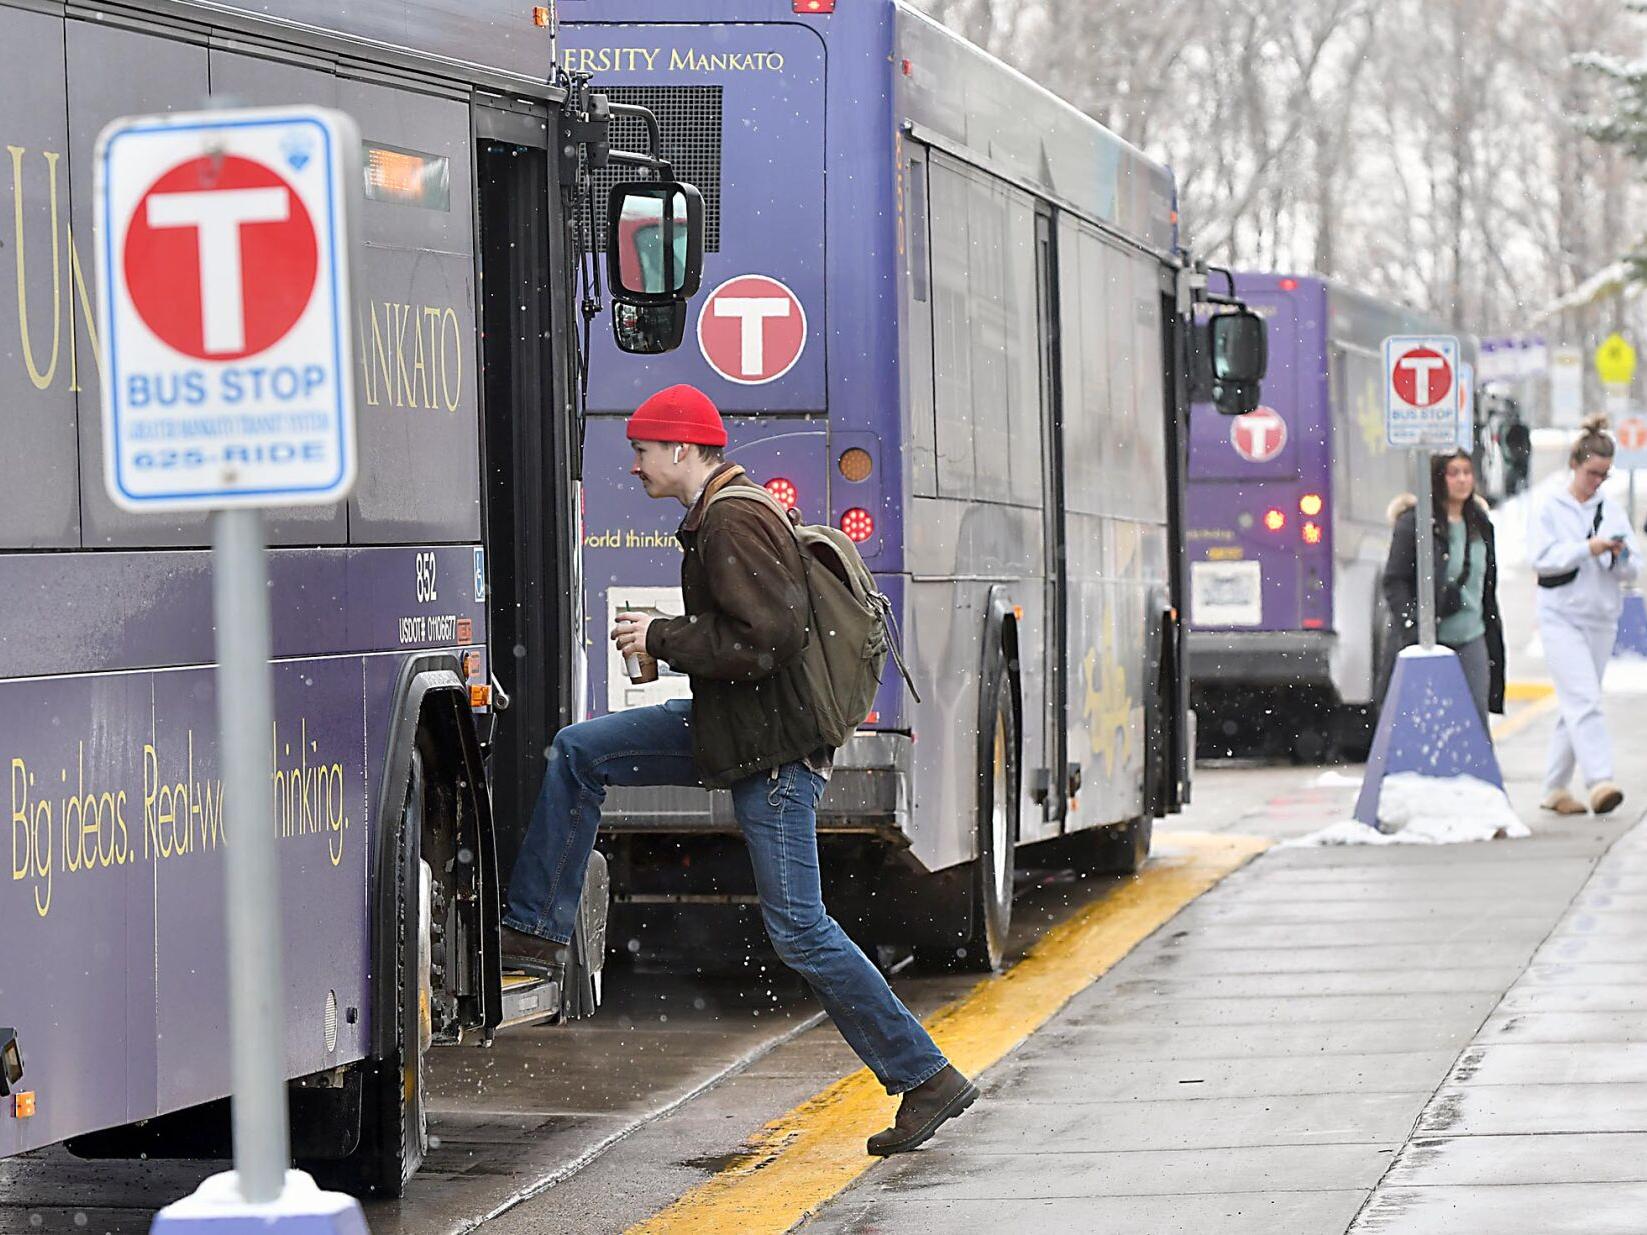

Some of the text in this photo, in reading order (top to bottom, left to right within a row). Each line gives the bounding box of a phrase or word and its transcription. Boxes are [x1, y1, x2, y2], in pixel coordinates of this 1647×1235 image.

[146, 186, 290, 353] T
[714, 298, 789, 374] T
[128, 365, 327, 407] BUS STOP
[1401, 358, 1444, 405] T
[1240, 416, 1277, 458] T
[626, 529, 684, 553] thinkin
[415, 551, 437, 603] 852
[11, 758, 52, 917] Big
[61, 740, 135, 872] ideas.
[272, 717, 349, 866] hinking.
